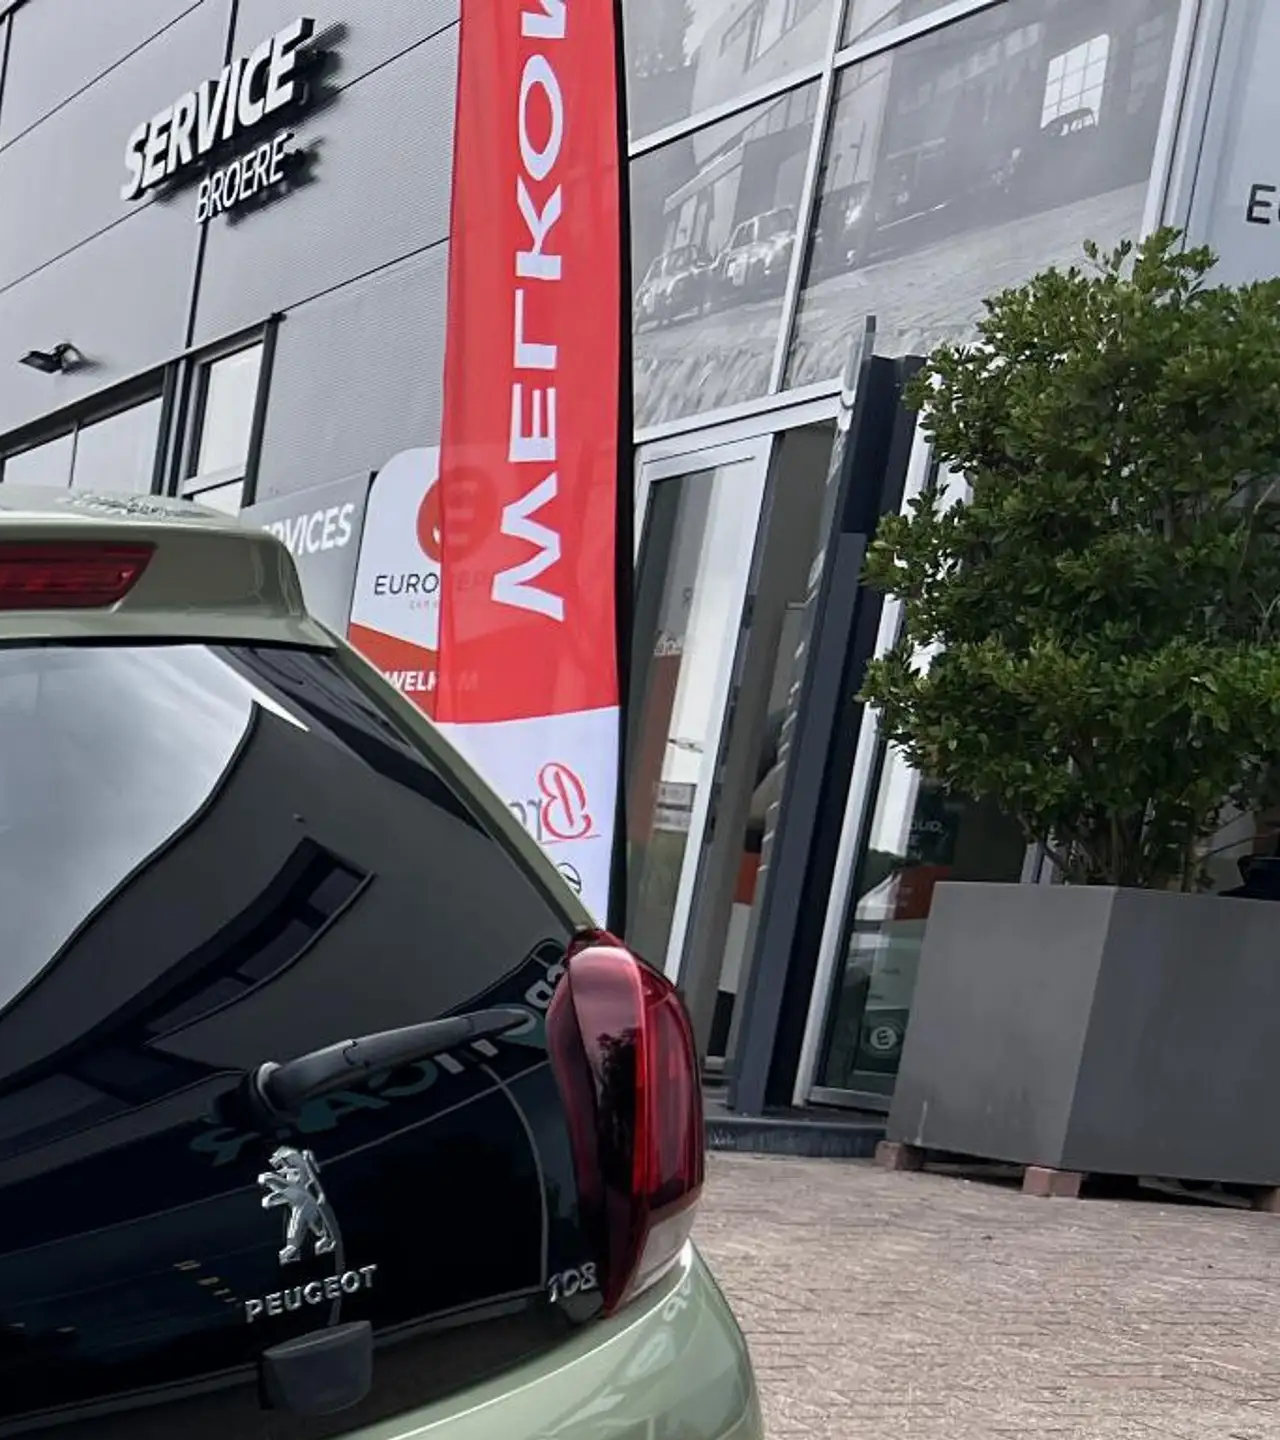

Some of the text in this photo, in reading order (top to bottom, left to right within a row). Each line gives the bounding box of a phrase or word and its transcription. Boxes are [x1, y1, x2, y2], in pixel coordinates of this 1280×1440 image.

[120, 17, 310, 201] SERVICE
[196, 132, 292, 223] BROERE
[261, 503, 356, 557] RVICES
[244, 1262, 379, 1323] PEUGEOT
[547, 1261, 598, 1303] 108
